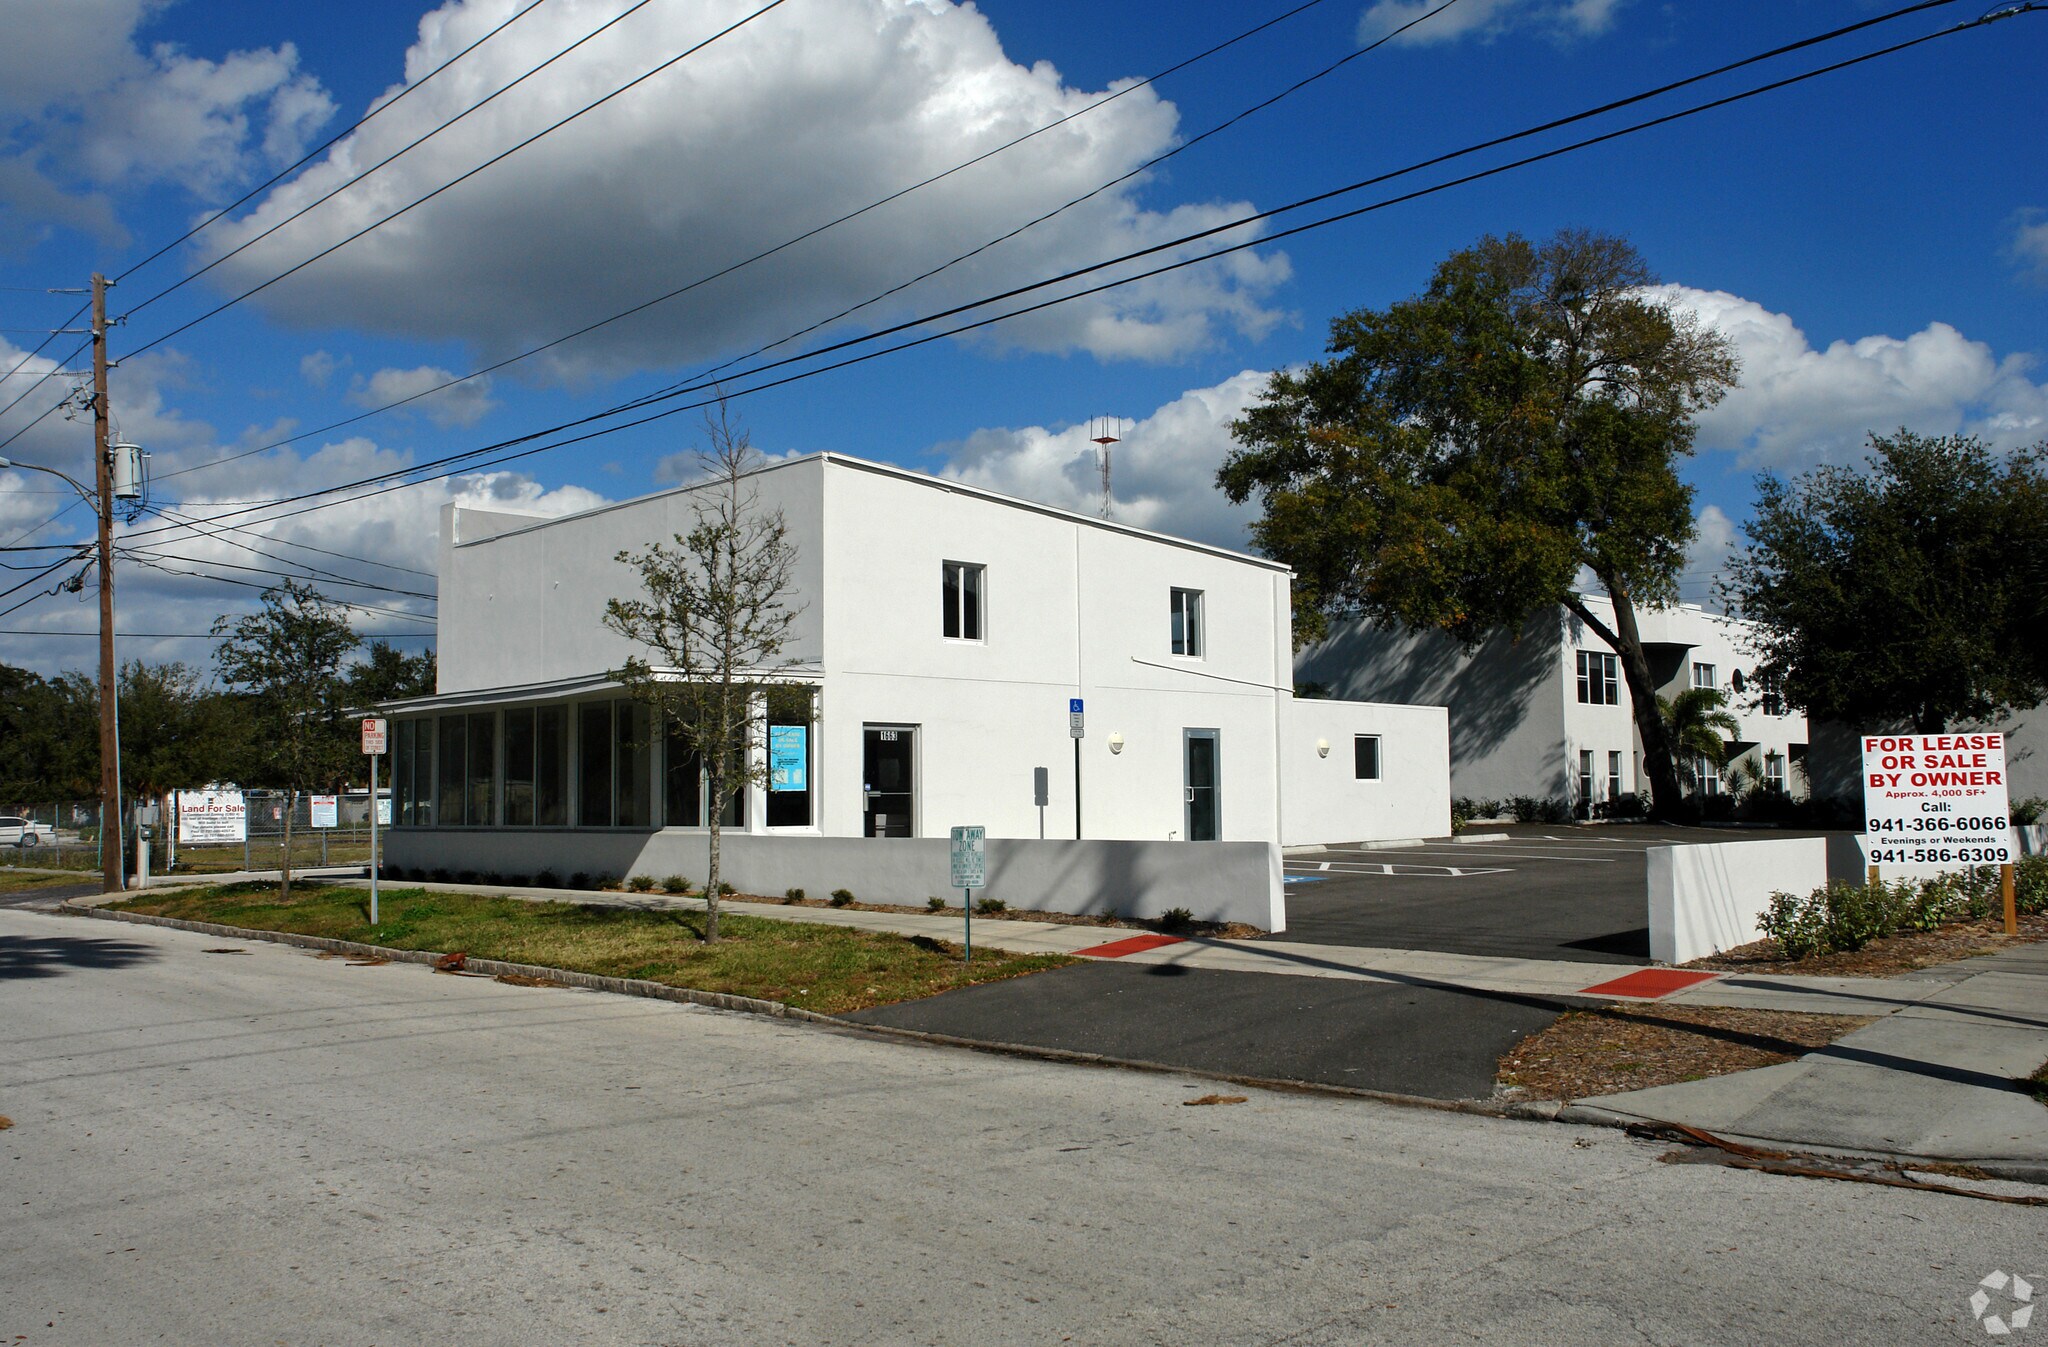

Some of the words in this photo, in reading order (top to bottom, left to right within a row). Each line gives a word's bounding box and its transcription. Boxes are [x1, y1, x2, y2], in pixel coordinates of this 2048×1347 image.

[364, 721, 375, 730] NO
[881, 731, 898, 740] 1663
[1866, 737, 1914, 752] FOR
[1923, 735, 2002, 750] LEASE
[1881, 755, 1916, 770] OR
[1924, 754, 1987, 768] SALE
[1869, 773, 1902, 787] BY
[1911, 771, 2002, 786] OWNER
[1885, 790, 1928, 799] Approx.
[1931, 789, 1962, 798] 4,000
[1921, 802, 1951, 812] Call:
[1869, 816, 2006, 832] 941-366-6066
[967, 829, 984, 840] AWAY
[959, 840, 975, 852] ZONE
[1881, 837, 1927, 845] Evenings
[1943, 836, 1996, 844] Weekends
[1870, 847, 2008, 863] 941-586-6309
